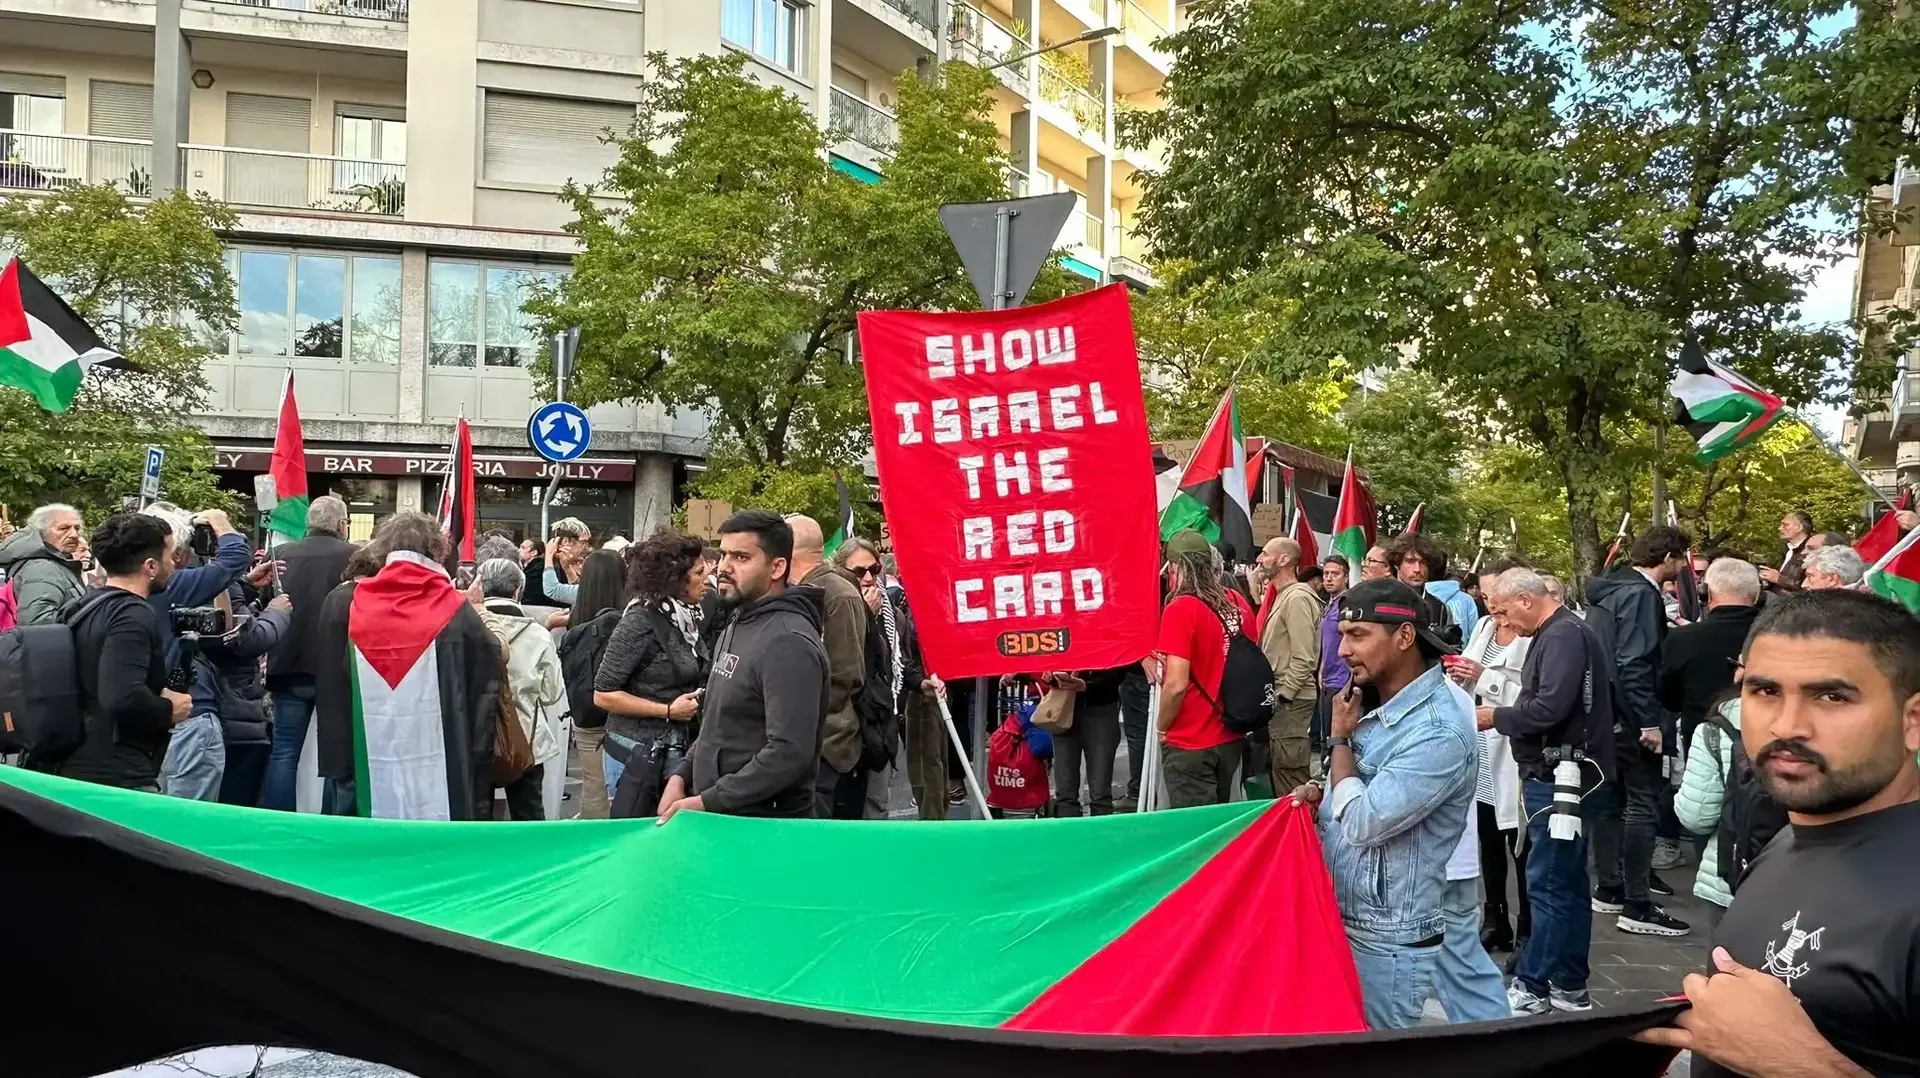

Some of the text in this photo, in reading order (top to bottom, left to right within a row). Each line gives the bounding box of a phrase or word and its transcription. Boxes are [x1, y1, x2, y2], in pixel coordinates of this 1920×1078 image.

[925, 326, 1076, 380] SHOW
[894, 382, 1118, 445] ISRAEL
[149, 453, 159, 473] P
[324, 457, 373, 472] BAR
[406, 459, 507, 476] PIZZRIA
[535, 463, 604, 479] JOLLY
[957, 446, 1073, 499] THE
[962, 509, 1076, 561] RED
[954, 567, 1104, 623] CARD
